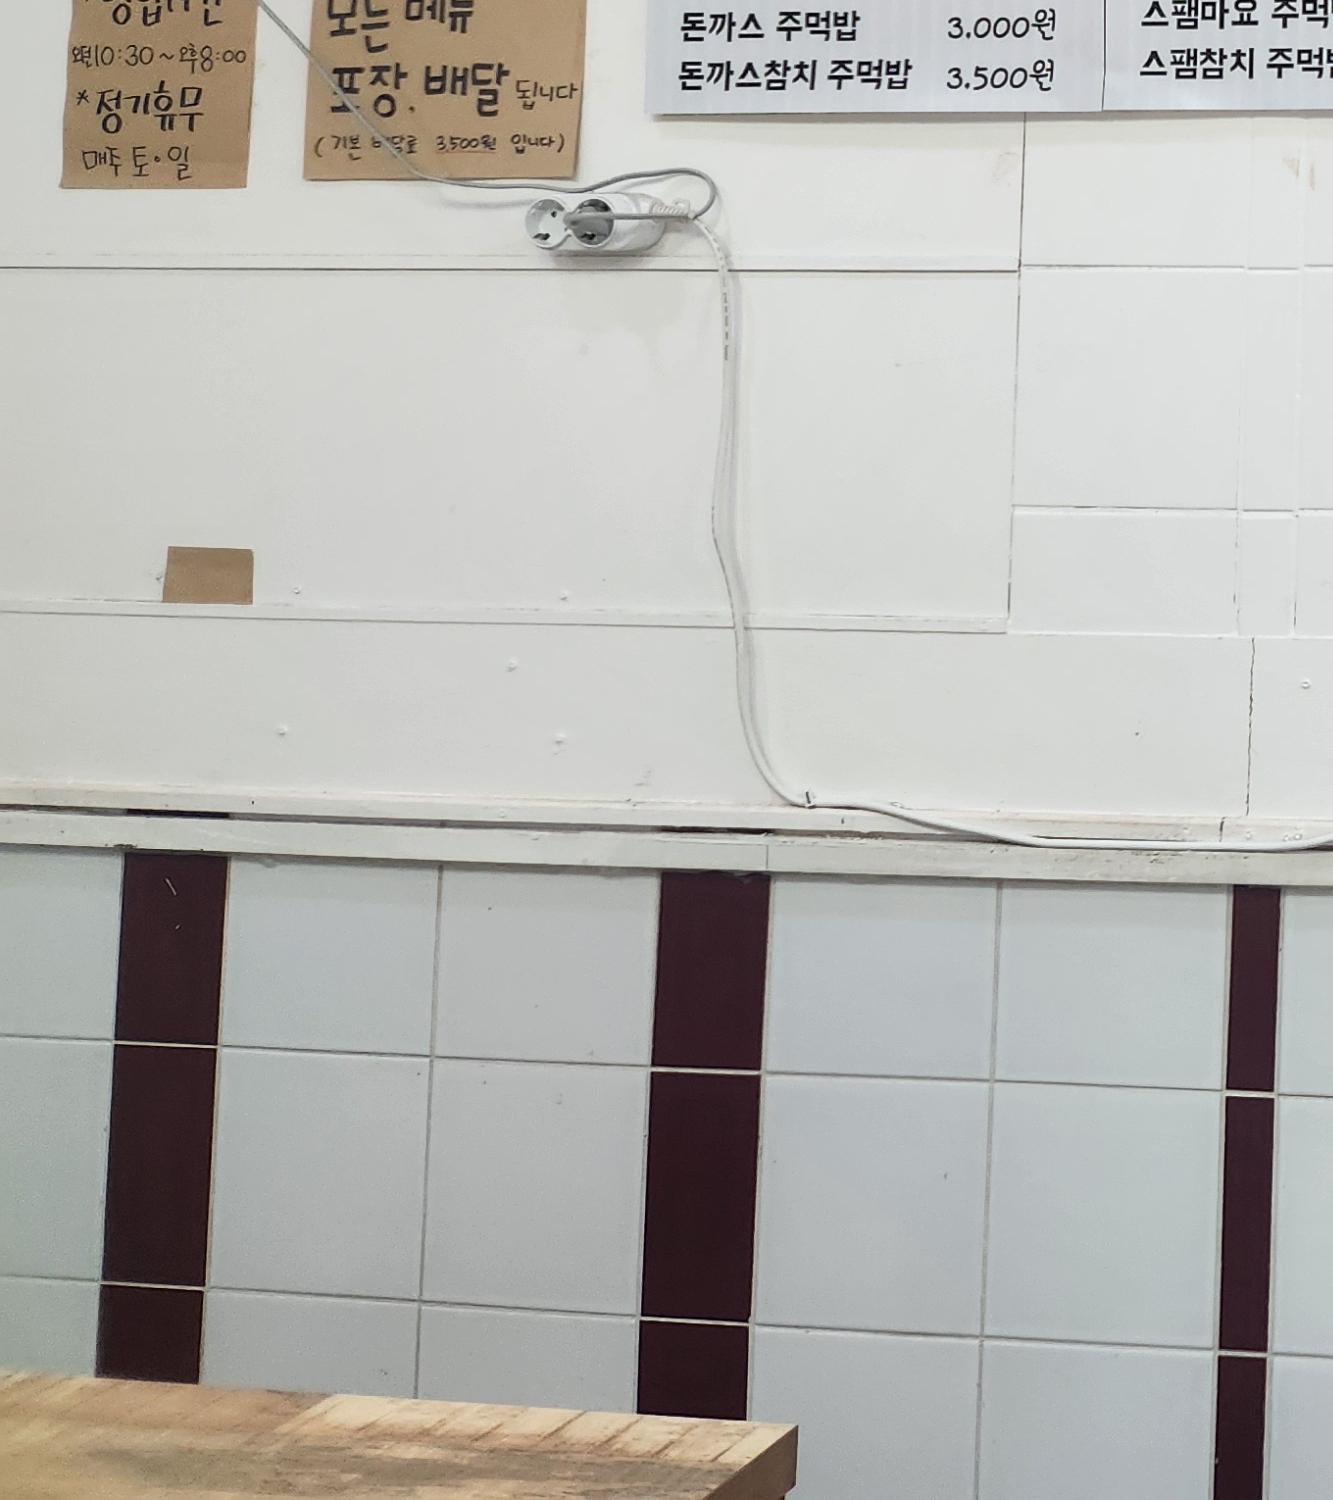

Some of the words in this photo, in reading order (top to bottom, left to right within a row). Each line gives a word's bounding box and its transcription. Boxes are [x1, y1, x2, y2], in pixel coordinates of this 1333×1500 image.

[680, 12, 765, 42] 돈까스
[776, 10, 861, 41] 주먹밥
[1140, 48, 1254, 80] 스팸참치
[423, 62, 510, 117] 배달
[515, 79, 578, 110] 됩니다
